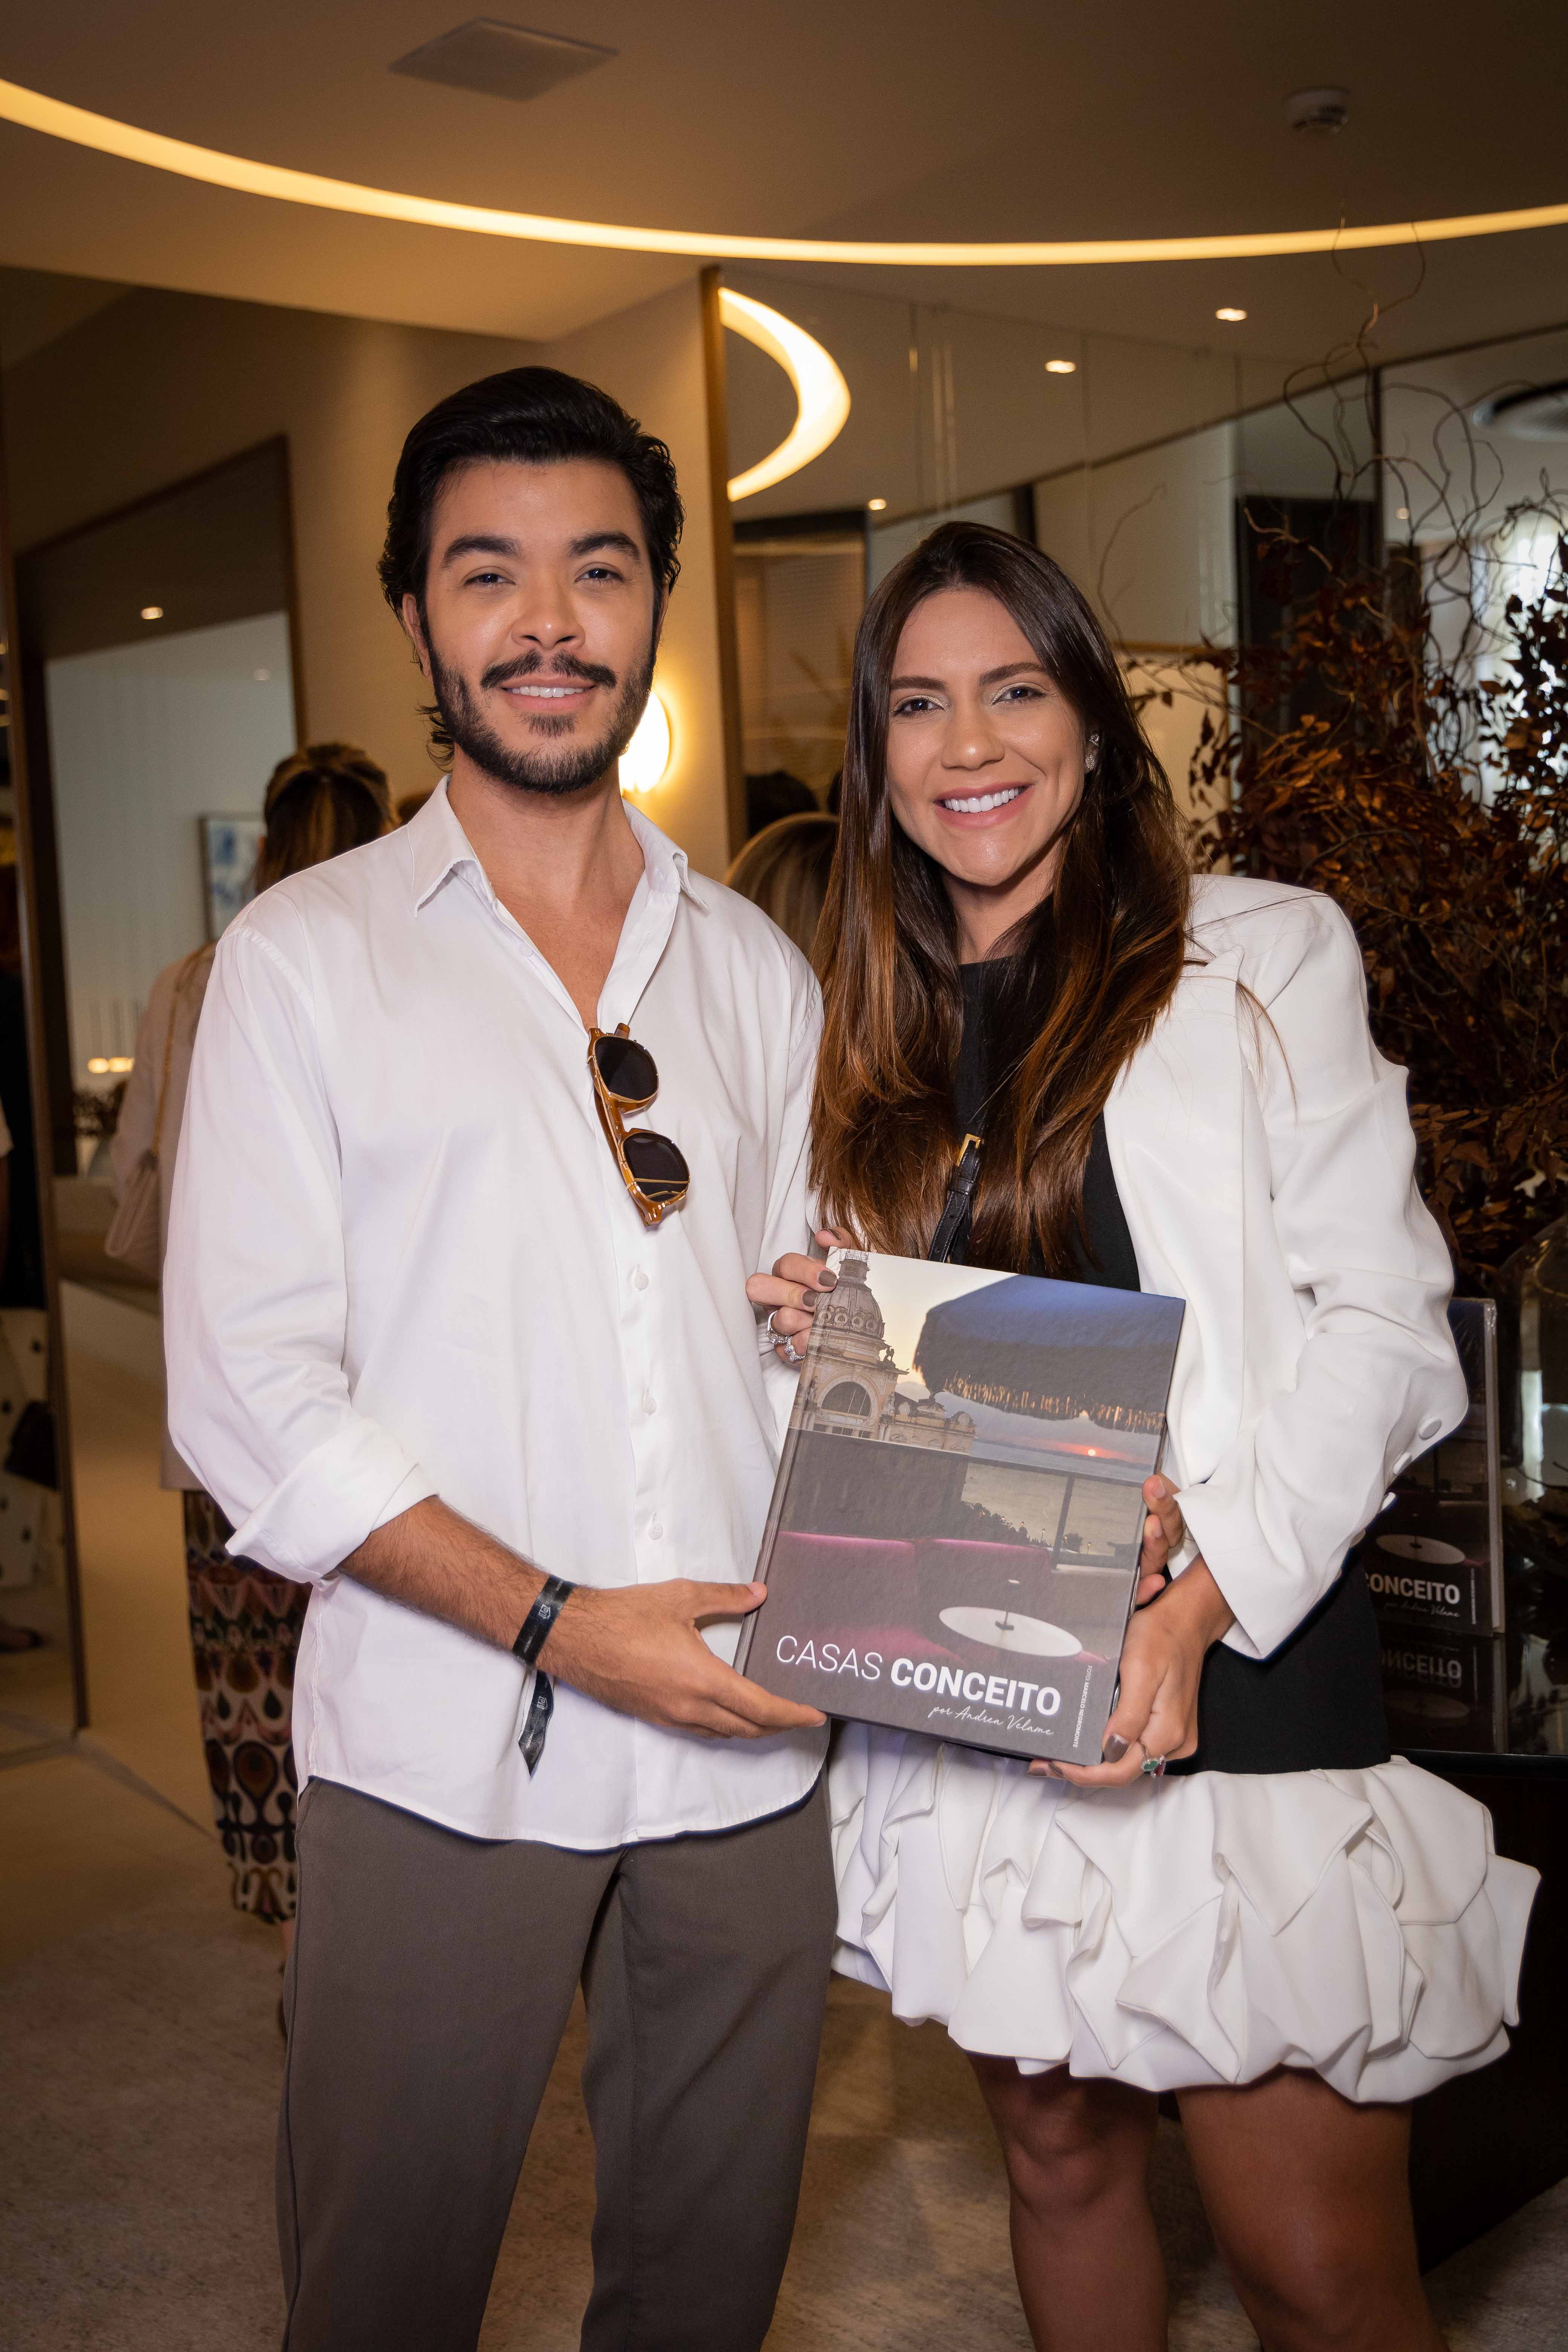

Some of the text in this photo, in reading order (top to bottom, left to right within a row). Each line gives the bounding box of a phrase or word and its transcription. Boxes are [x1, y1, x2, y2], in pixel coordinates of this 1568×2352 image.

[1365, 1572, 1460, 1605] ONCEITO
[776, 1635, 1061, 1716] CASAS CONCEITO
[1080, 1681, 1089, 1708] MARCELO
[928, 1704, 1054, 1736] por Andrea Velame
[1072, 1709, 1084, 1748] NEGROMONTE
